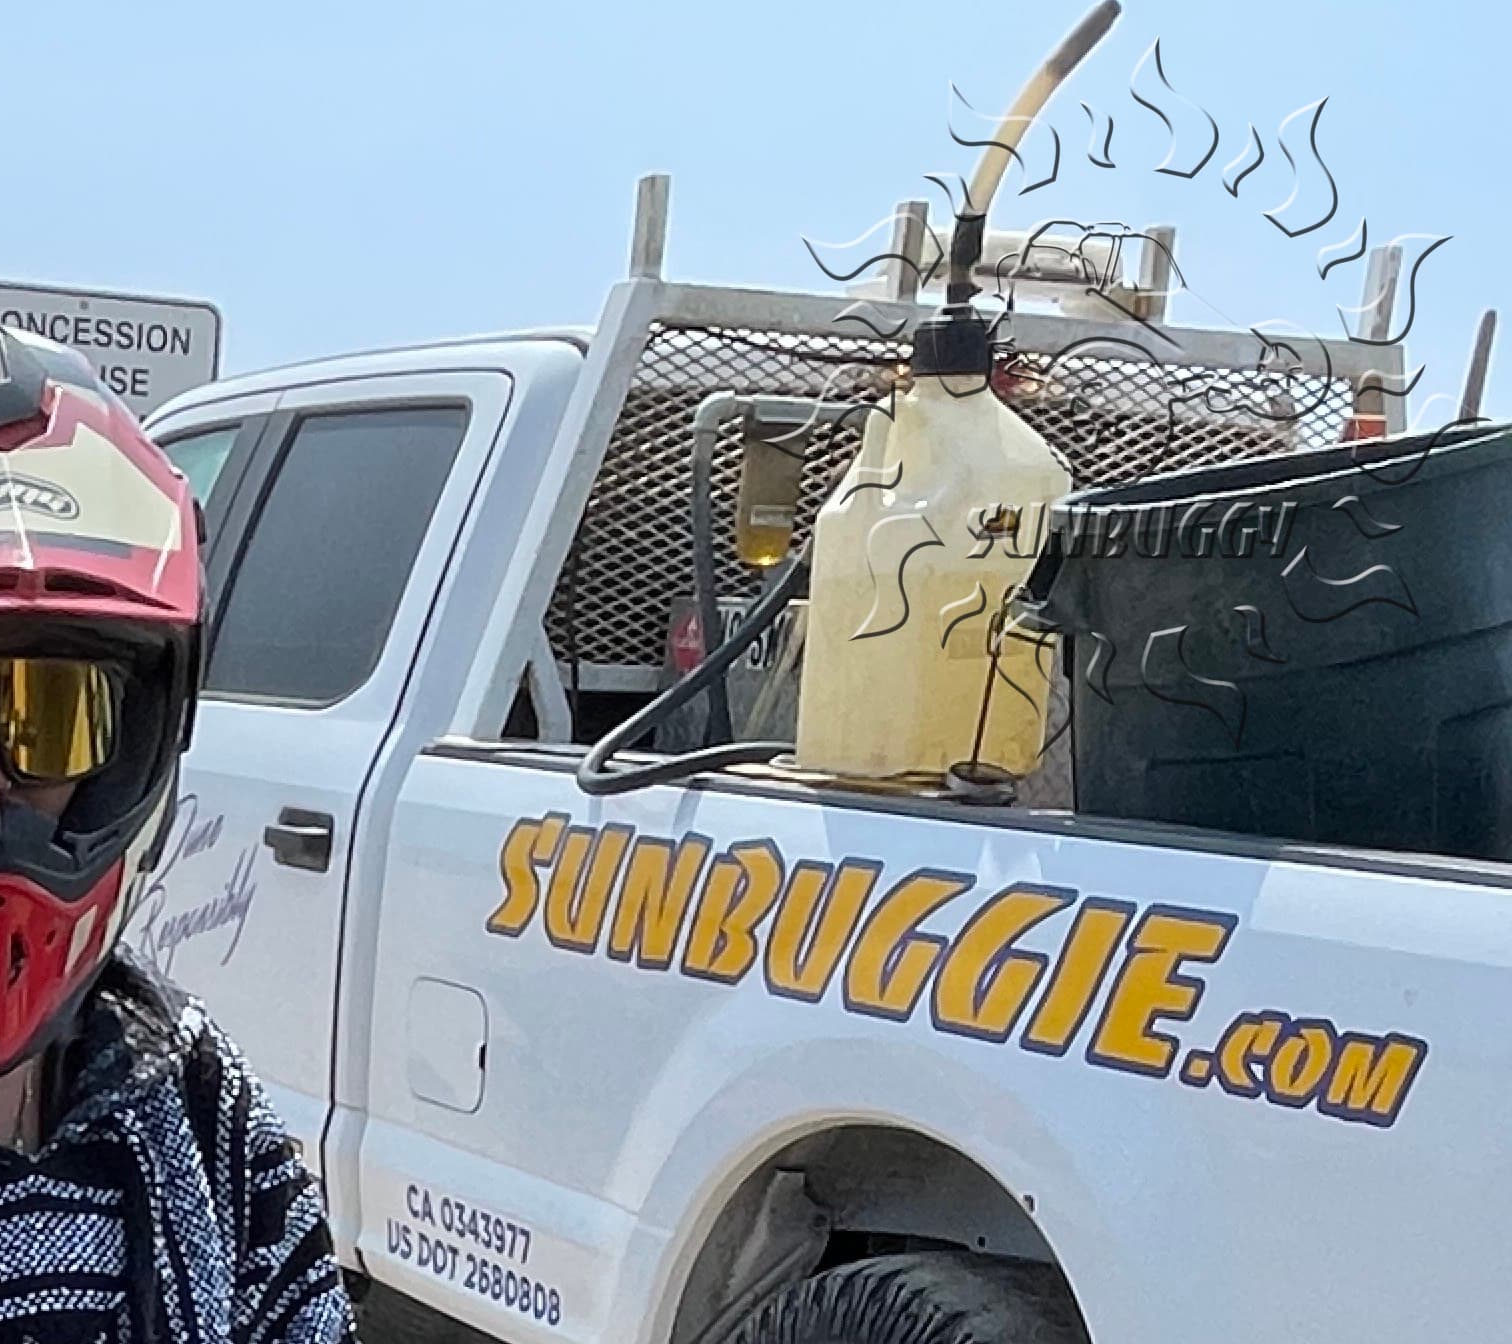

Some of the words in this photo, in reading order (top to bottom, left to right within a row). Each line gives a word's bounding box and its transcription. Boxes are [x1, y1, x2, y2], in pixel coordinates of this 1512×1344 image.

[407, 1184, 436, 1227] CA
[441, 1197, 532, 1264] 0343977
[387, 1217, 412, 1260] US
[417, 1231, 460, 1280] DOT
[464, 1252, 561, 1326] 2680808
